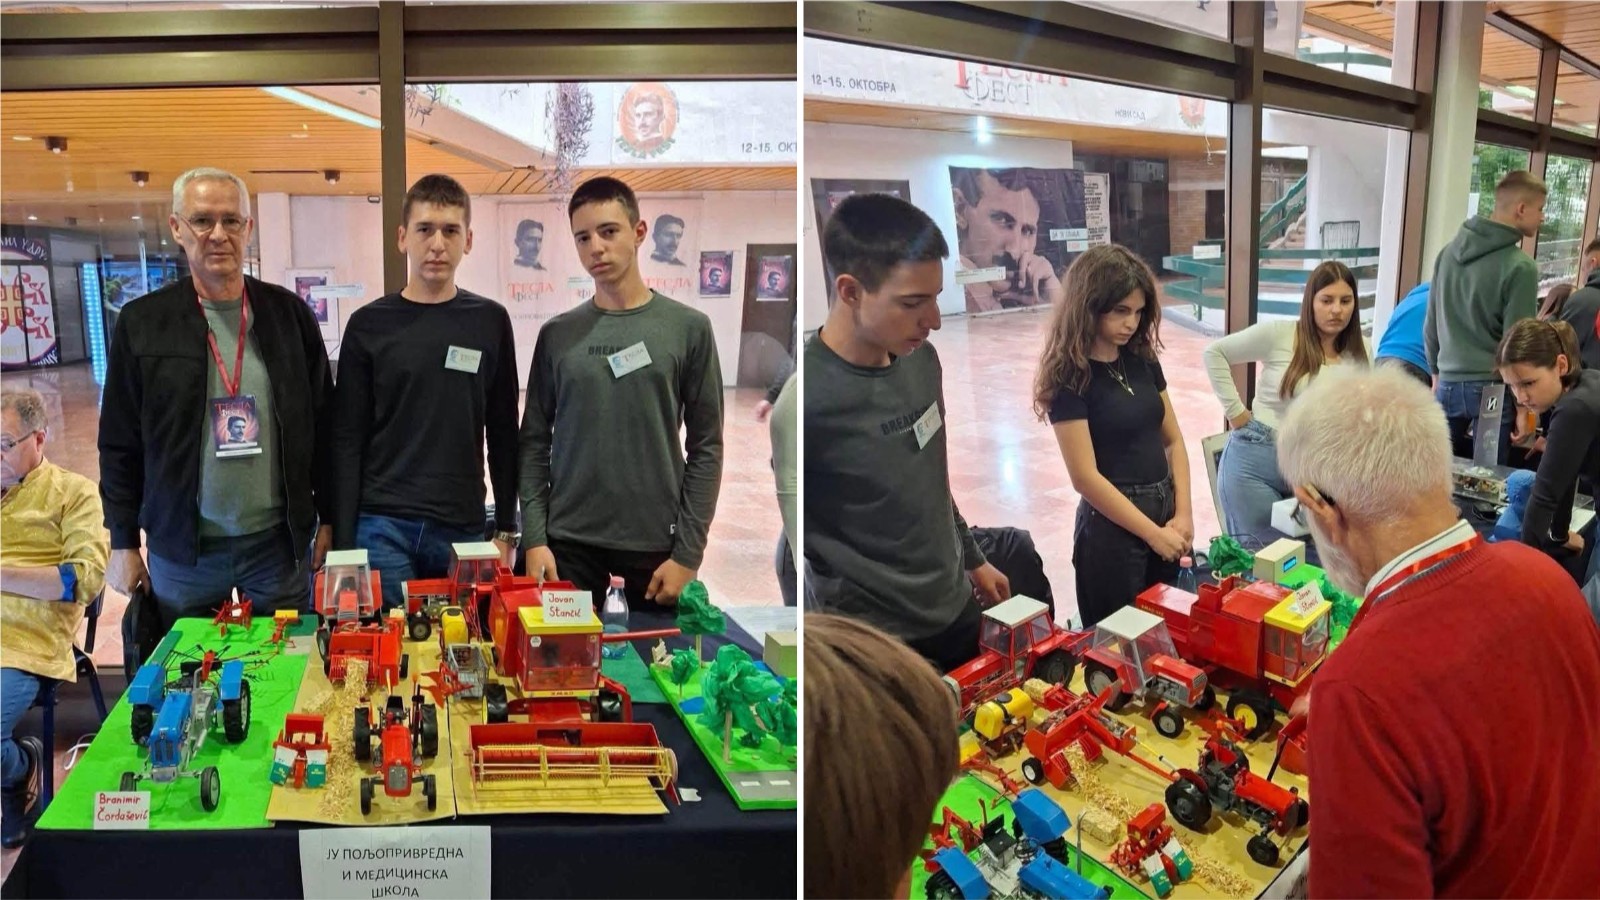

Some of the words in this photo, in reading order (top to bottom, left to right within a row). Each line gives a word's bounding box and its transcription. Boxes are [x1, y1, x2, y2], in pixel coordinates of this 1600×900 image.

[811, 73, 845, 89] 12-15.
[848, 78, 896, 93] ОКТОБРА
[741, 142, 772, 153] 12-15.
[549, 592, 574, 604] Jovan
[99, 792, 141, 805] Branimir
[326, 848, 340, 860] ЈУ
[343, 847, 464, 861] ПОЉОПРИВРЕДНА
[342, 870, 351, 881] И
[355, 867, 448, 882] МЕДИЦИНСКА
[371, 884, 419, 899] ШКОЛА
